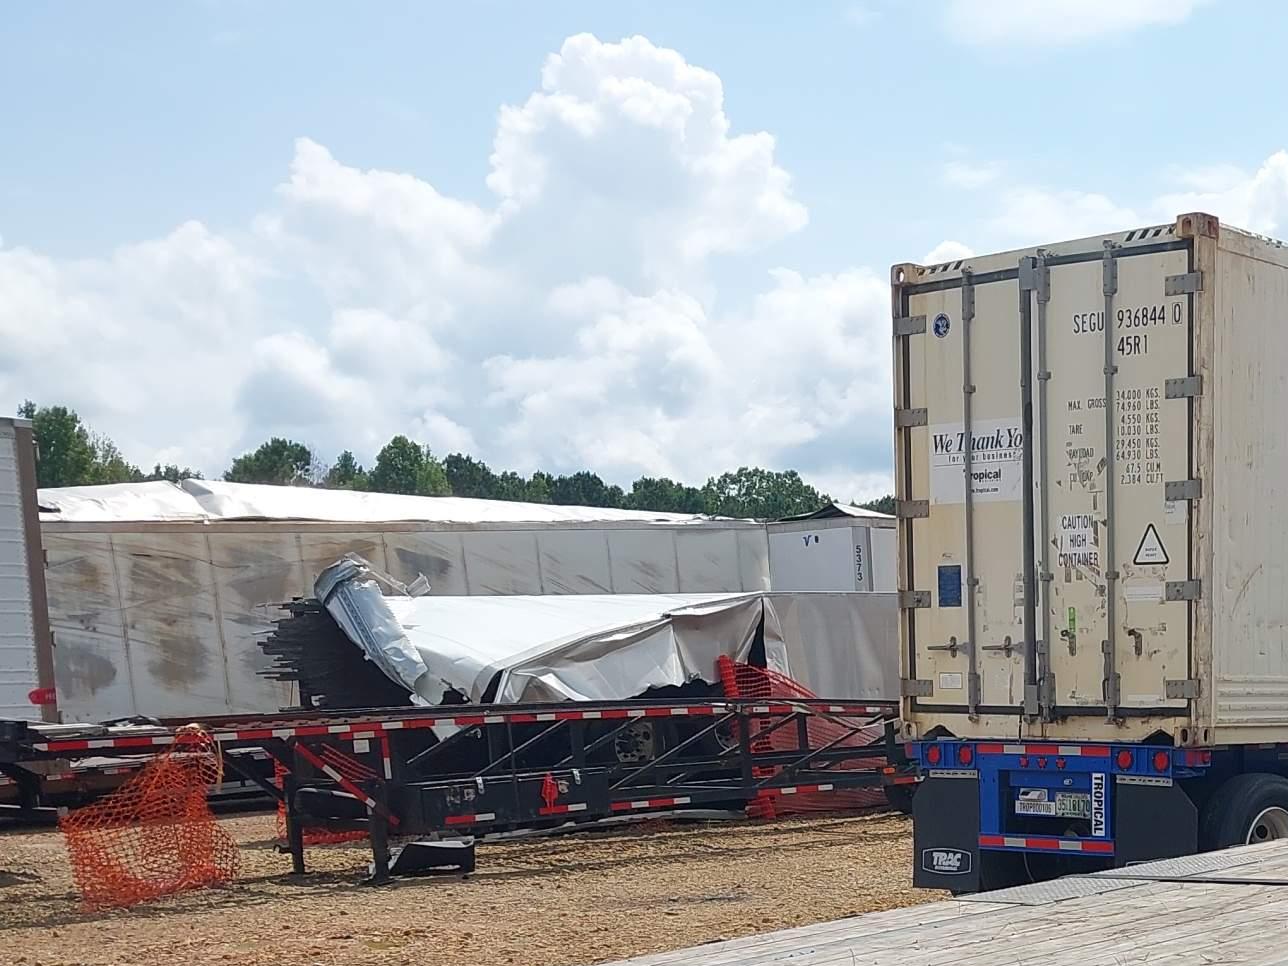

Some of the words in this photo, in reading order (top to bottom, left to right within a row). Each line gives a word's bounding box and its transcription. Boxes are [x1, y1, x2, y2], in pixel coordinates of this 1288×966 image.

[1073, 312, 1104, 333] SEGU
[1117, 305, 1165, 328] 936844
[1117, 334, 1147, 355] 45R1
[1067, 400, 1082, 411] MAX.
[1087, 398, 1106, 409] GROSS
[1145, 399, 1160, 410] LBS.
[1120, 413, 1141, 424] 4.550
[1145, 412, 1160, 423] KGS.
[1069, 424, 1083, 435] TARE
[1117, 425, 1141, 436] 10.030
[1145, 424, 1160, 435] LBS.
[933, 434, 953, 454] We
[956, 428, 1004, 452] Thank
[1116, 438, 1141, 449] 29.450
[1145, 437, 1160, 448] KGS.
[948, 455, 960, 463] for
[1145, 448, 1160, 459] LBS.
[1125, 462, 1141, 473] 67.5
[1061, 514, 1094, 530] CAUTION
[1069, 534, 1087, 548] HIGH
[855, 544, 864, 582] 5373
[1058, 551, 1099, 568] CONTAINER
[1093, 774, 1104, 835] TROPICAL
[932, 852, 962, 867] TRAC
